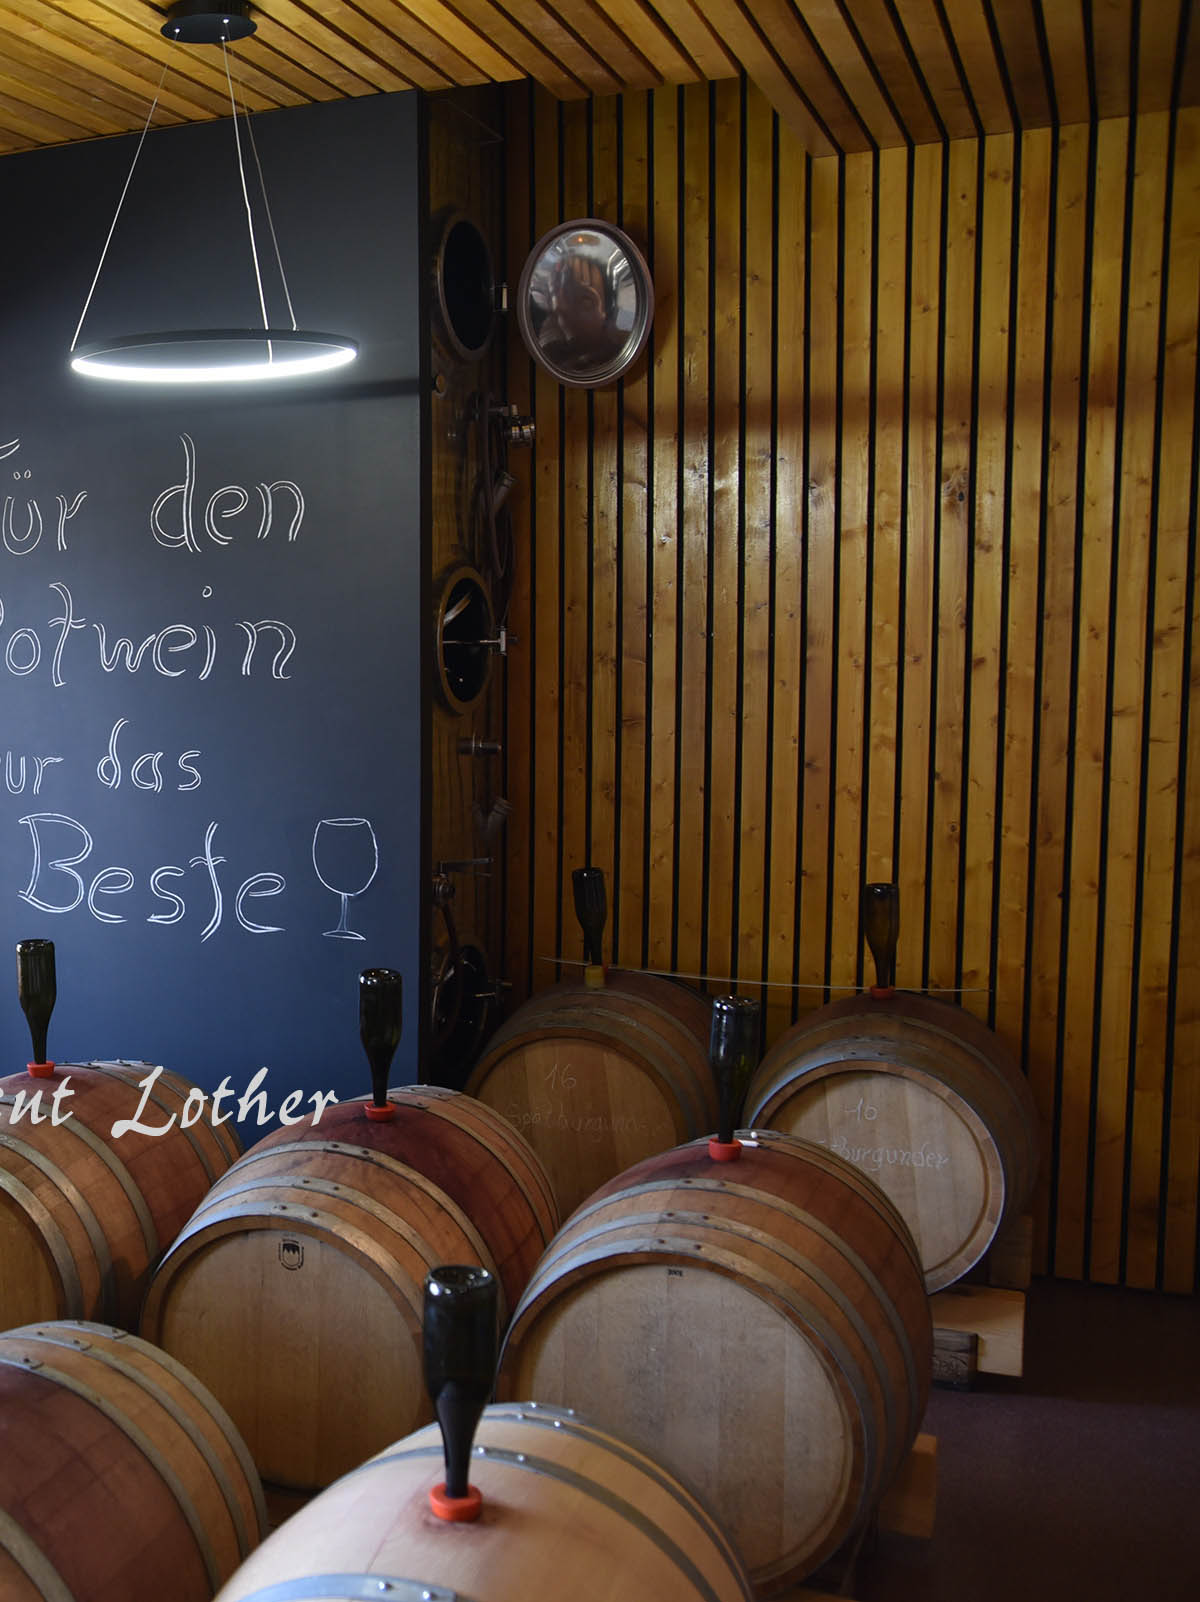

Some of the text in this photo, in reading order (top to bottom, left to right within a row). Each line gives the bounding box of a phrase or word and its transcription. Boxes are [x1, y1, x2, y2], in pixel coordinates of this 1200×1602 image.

[151, 433, 305, 553] den
[97, 717, 203, 793] das
[17, 812, 288, 943] Beste
[543, 1063, 578, 1090] 16
